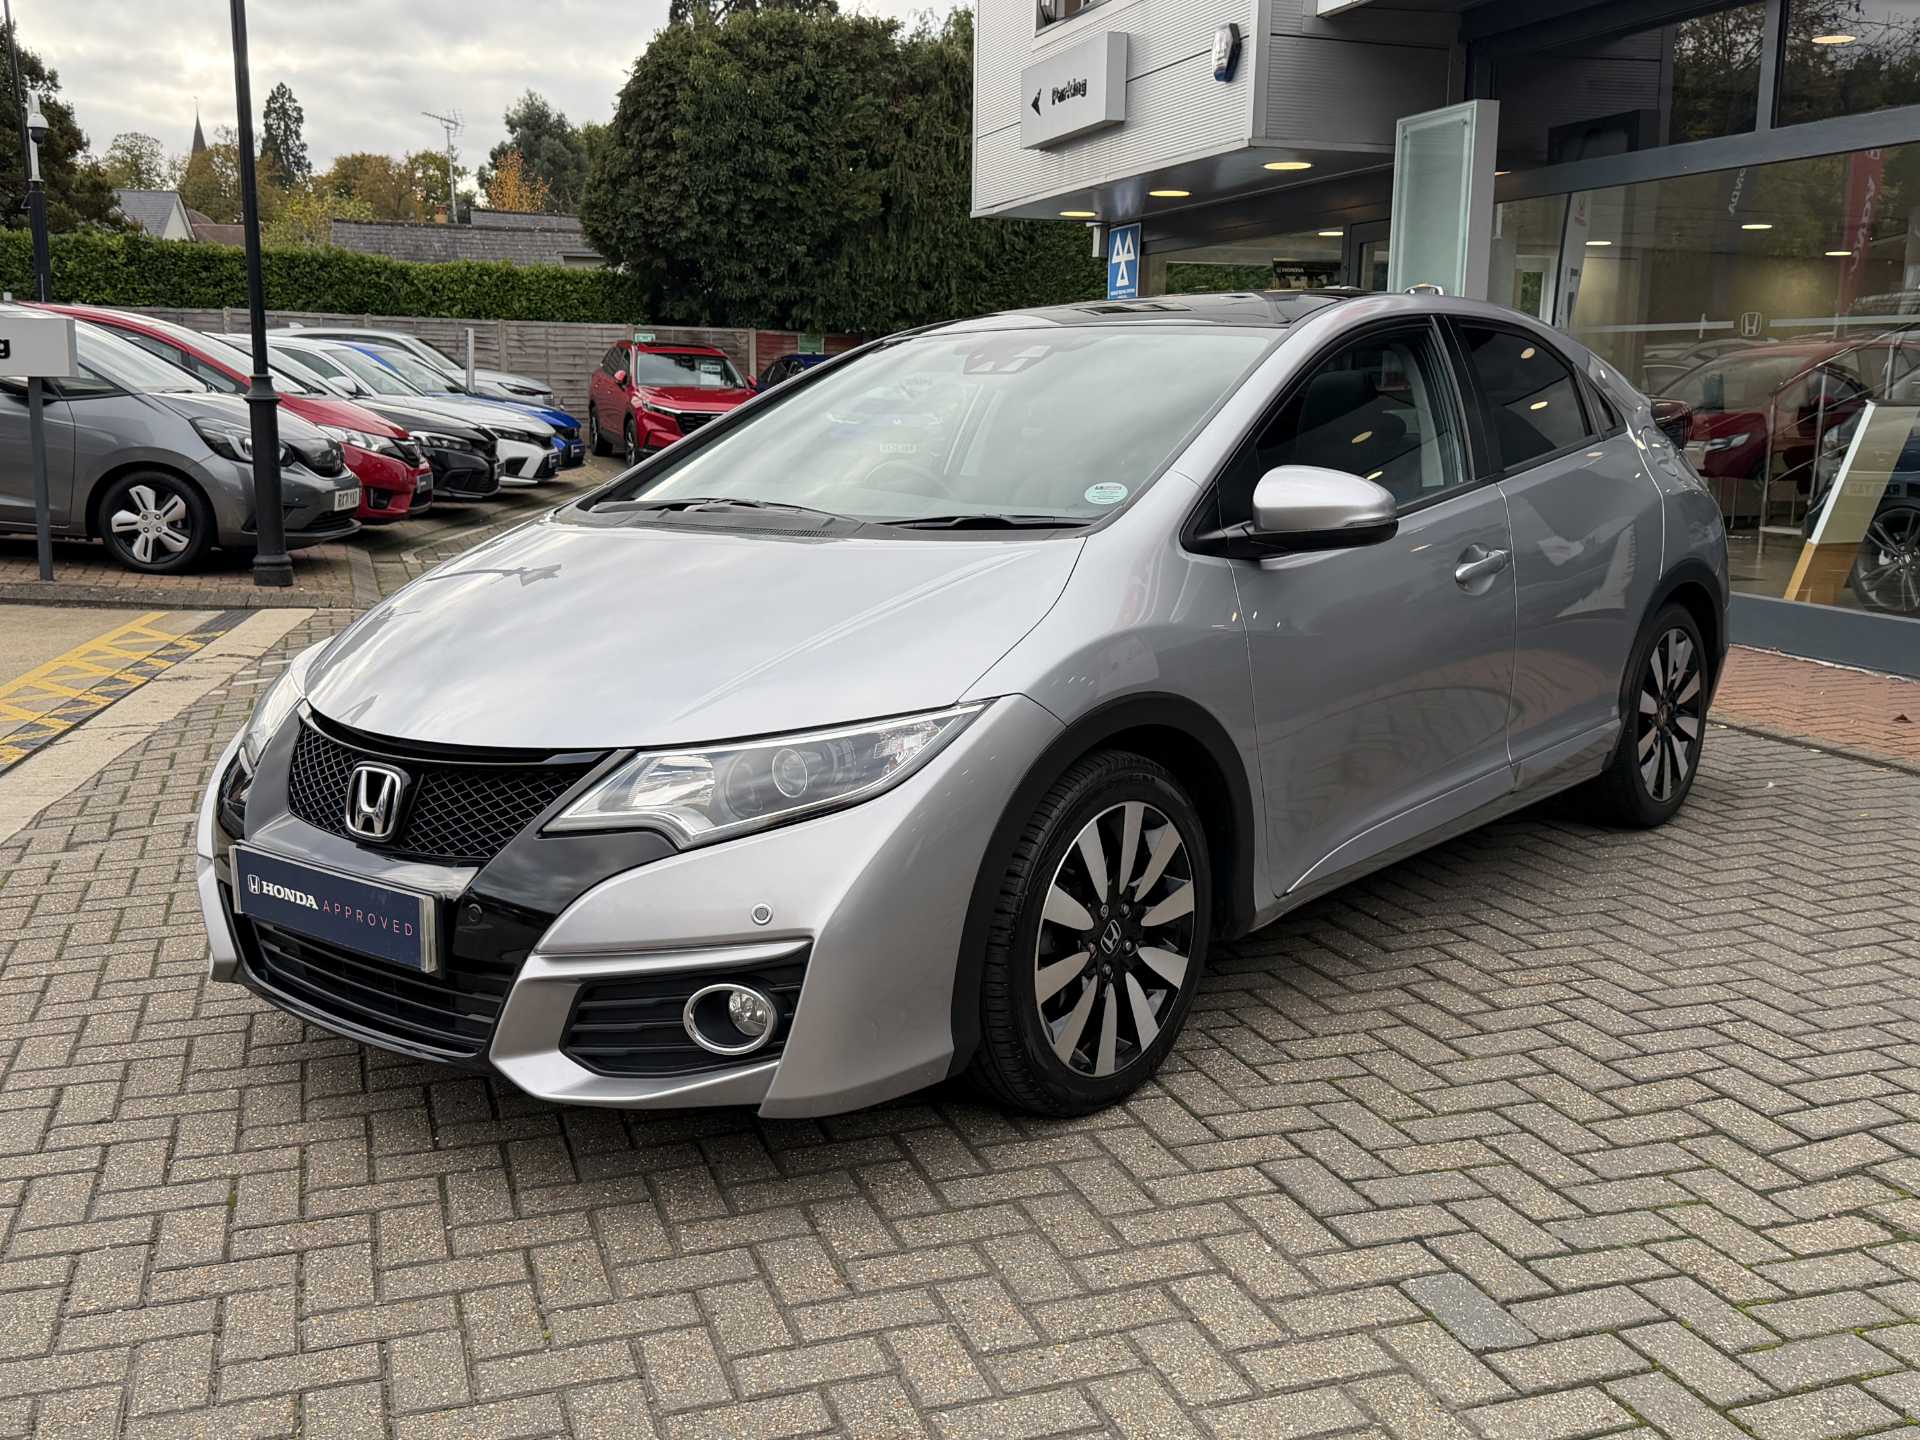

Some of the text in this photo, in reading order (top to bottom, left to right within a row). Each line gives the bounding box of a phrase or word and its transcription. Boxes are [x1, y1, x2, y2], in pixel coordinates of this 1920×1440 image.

[1052, 78, 1087, 105] Parking
[260, 880, 413, 936] HONDA APPROVED
